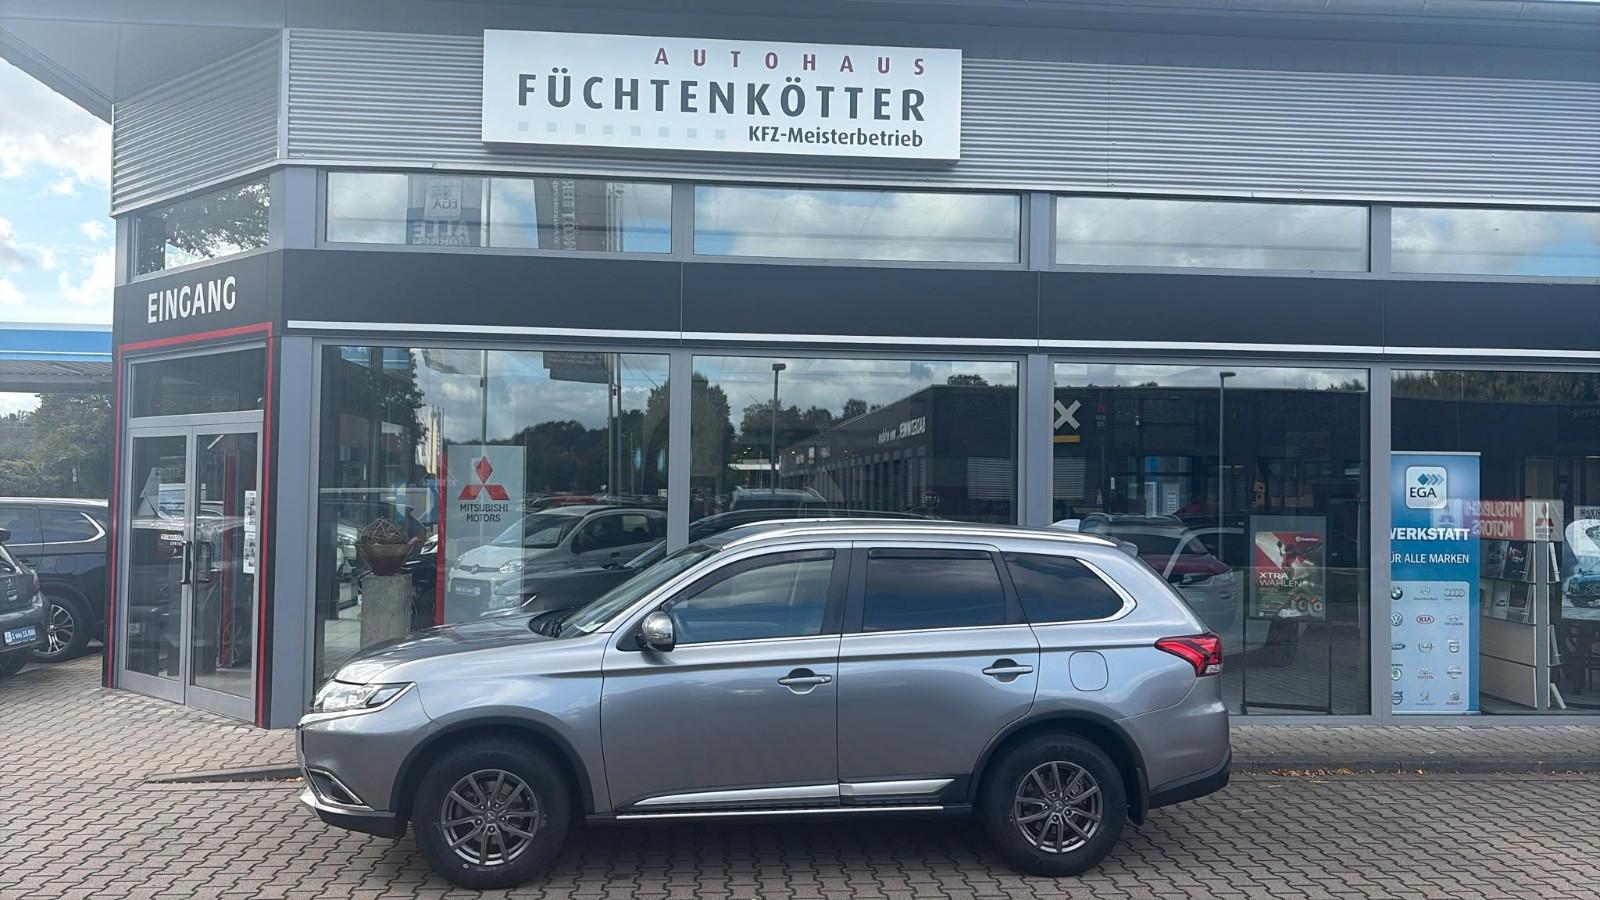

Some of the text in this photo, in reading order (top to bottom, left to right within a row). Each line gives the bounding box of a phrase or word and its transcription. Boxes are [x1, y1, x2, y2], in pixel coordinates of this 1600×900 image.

[654, 47, 924, 75] AUTOHAUS
[518, 67, 925, 122] FÜCHTENKÖTTER
[748, 126, 924, 148] KFZ-Meisterbetrieb
[147, 275, 236, 323] EINGANG
[1409, 487, 1437, 499] EGA
[460, 503, 509, 513] MITSUBISHI
[466, 513, 501, 523] MOTORS
[1404, 553, 1427, 563] ALLE
[1429, 553, 1470, 564] MARKEN
[1418, 615, 1433, 623] KIA
